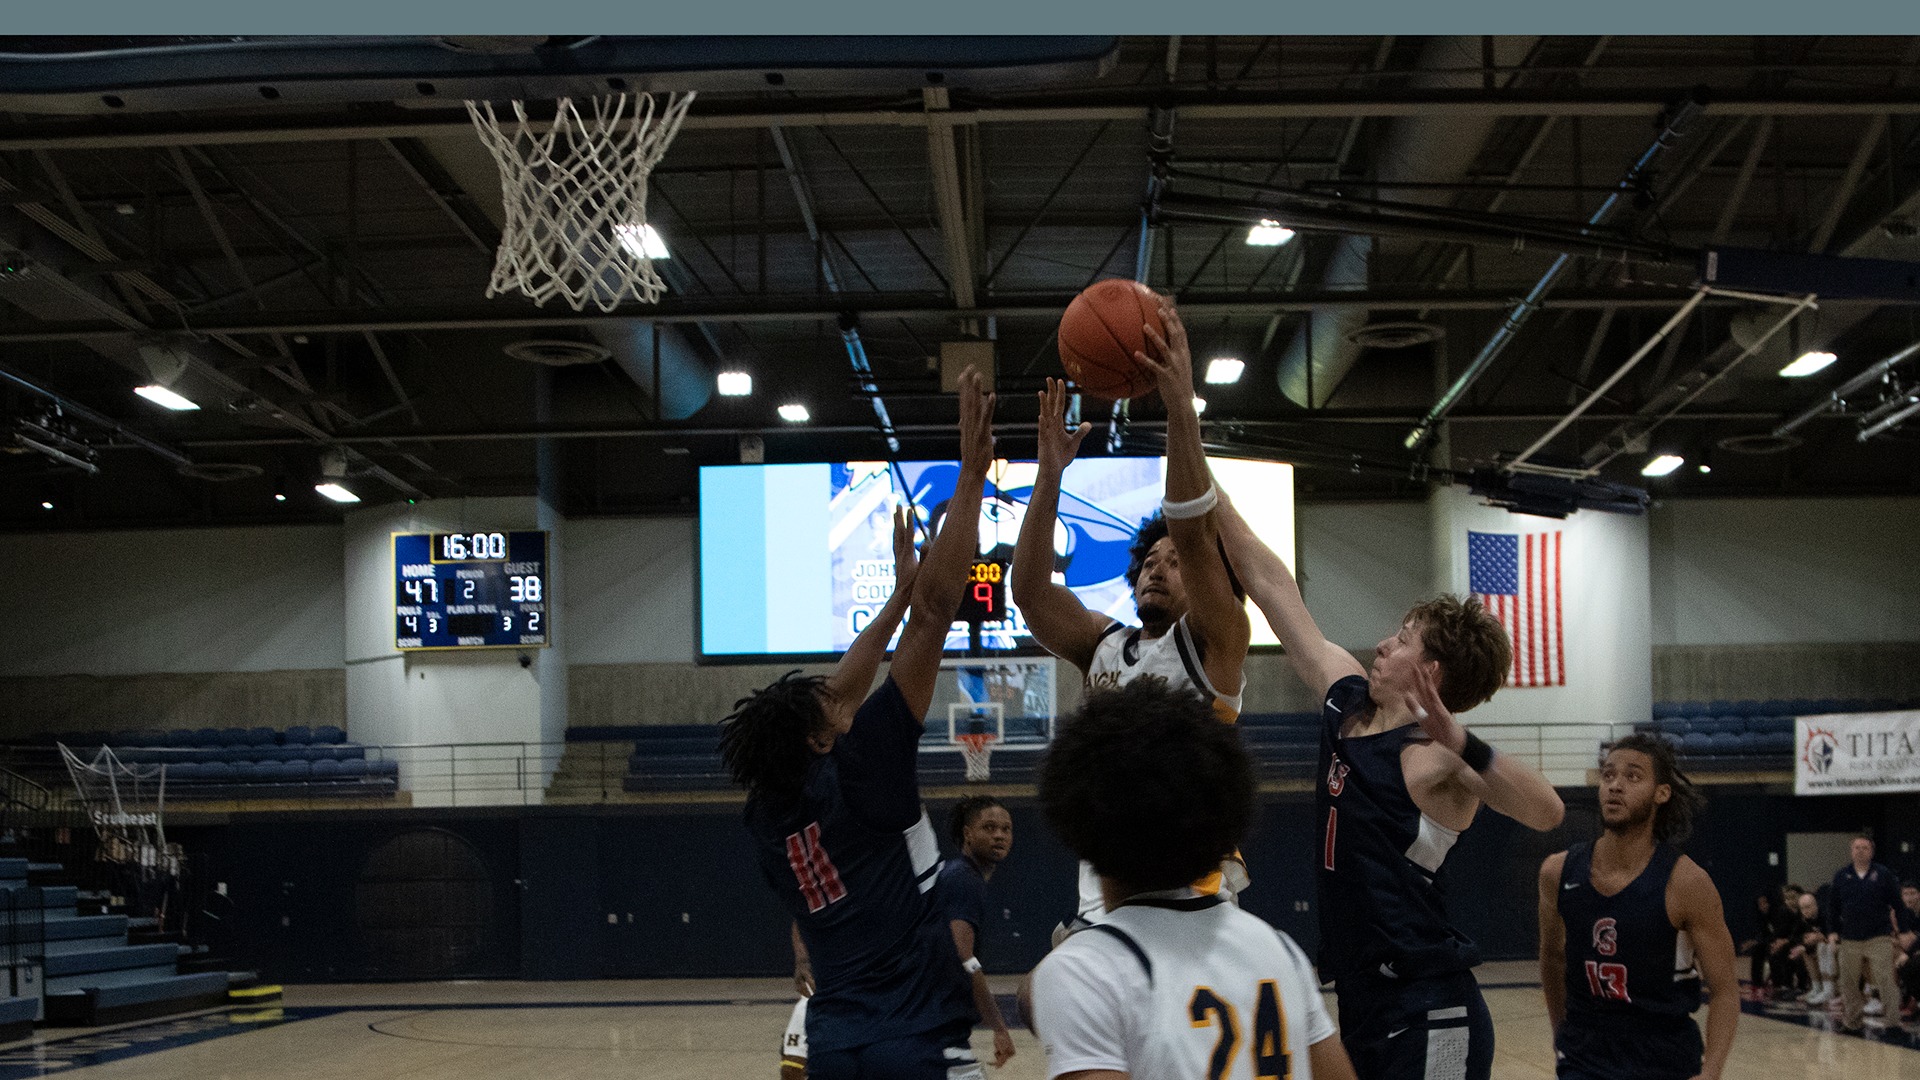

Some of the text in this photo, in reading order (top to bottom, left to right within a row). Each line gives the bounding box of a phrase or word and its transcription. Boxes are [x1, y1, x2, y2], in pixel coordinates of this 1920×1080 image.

[443, 533, 506, 560] 16:00
[402, 564, 436, 578] HOME
[503, 562, 540, 575] GUEST
[405, 579, 439, 603] 47
[463, 580, 475, 599] 2
[510, 576, 542, 602] 38
[973, 582, 993, 613] 9
[405, 617, 417, 633] 4
[429, 618, 438, 633] 3
[503, 617, 512, 631] 3
[528, 612, 540, 631] 2
[1846, 731, 1920, 757] TITA
[1325, 806, 1335, 871] 1
[786, 821, 848, 914] 11
[1585, 961, 1632, 1002] 13
[1187, 978, 1292, 1080] 24
